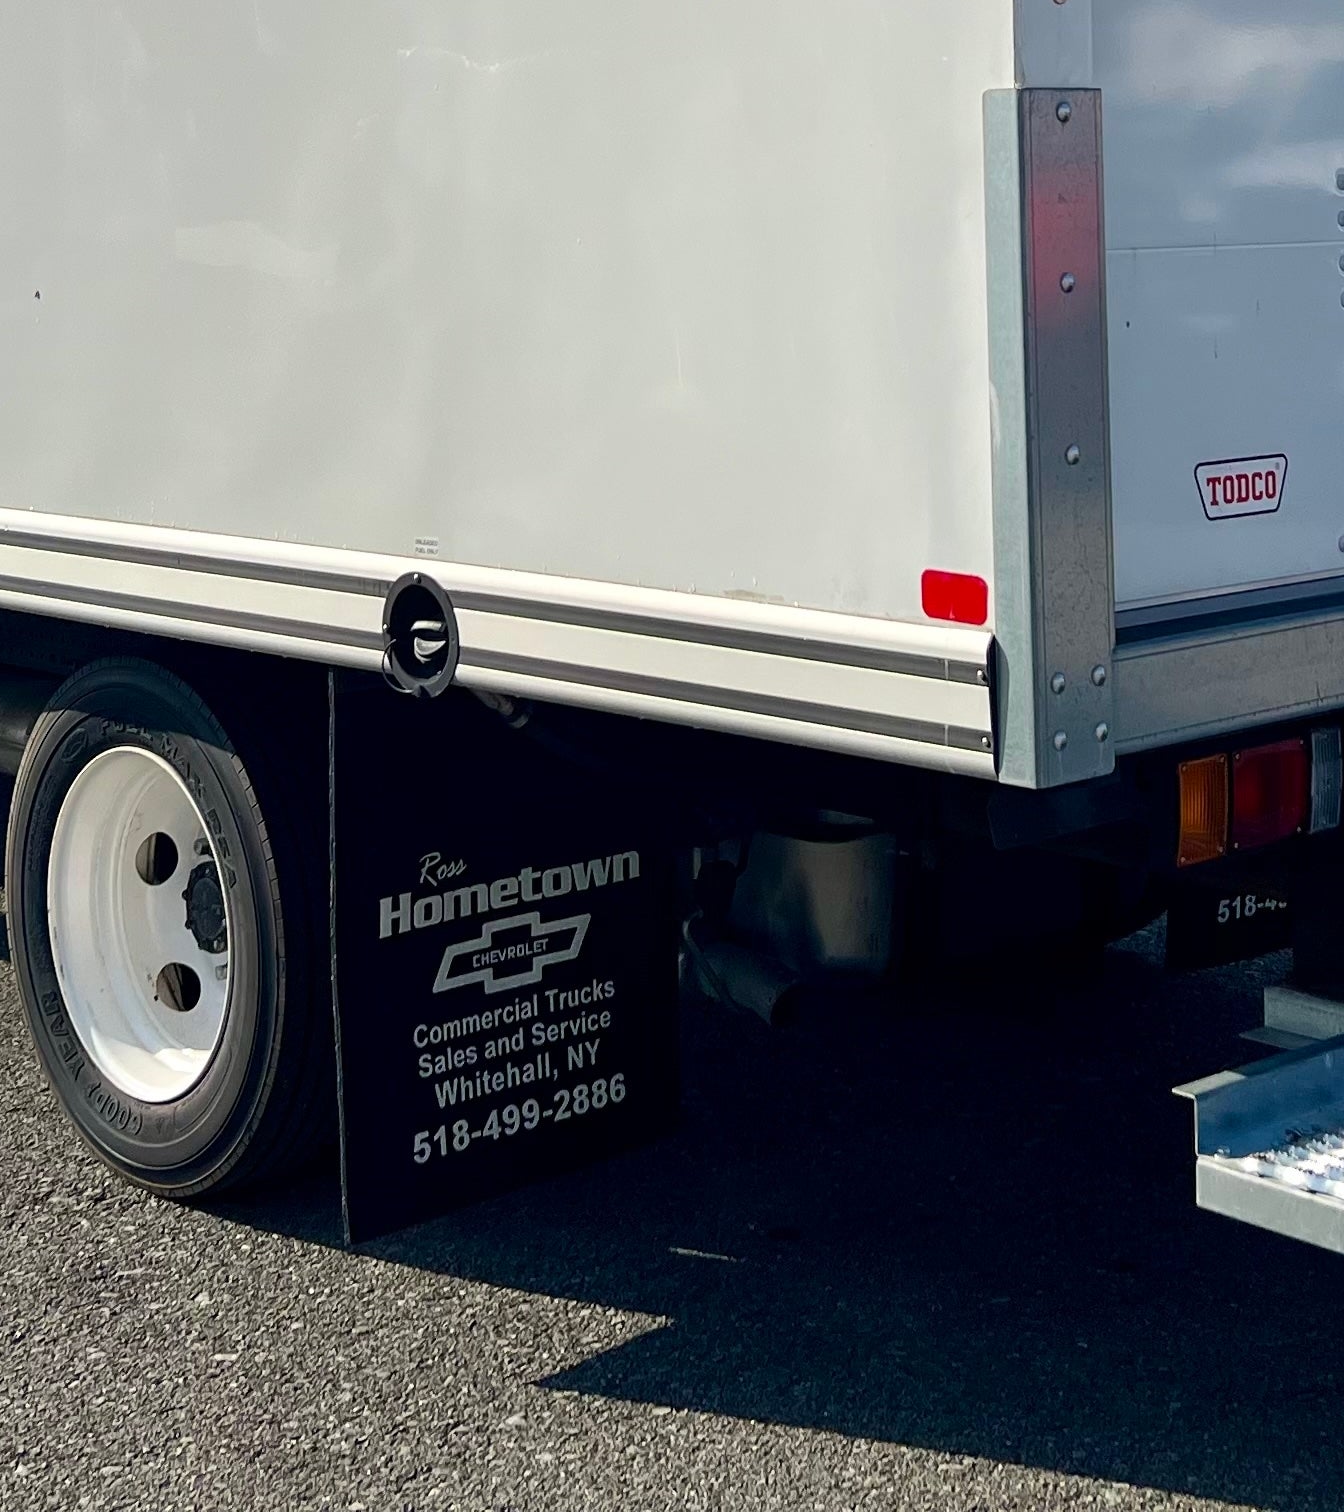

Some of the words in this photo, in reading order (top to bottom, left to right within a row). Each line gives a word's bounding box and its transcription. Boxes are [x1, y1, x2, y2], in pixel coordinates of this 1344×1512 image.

[1206, 470, 1277, 506] TODCO
[379, 850, 641, 939] Hometown
[419, 852, 467, 886] Ross
[472, 938, 550, 969] CHEVROLET
[413, 994, 539, 1049] Commercial
[545, 978, 616, 1014] Trucks
[418, 1047, 478, 1078] Sales
[485, 1027, 525, 1060] and
[531, 1010, 612, 1047] Service
[434, 1053, 559, 1110] Whitehall,
[567, 1039, 602, 1072] NY
[412, 1073, 627, 1164] 518-499-2886
